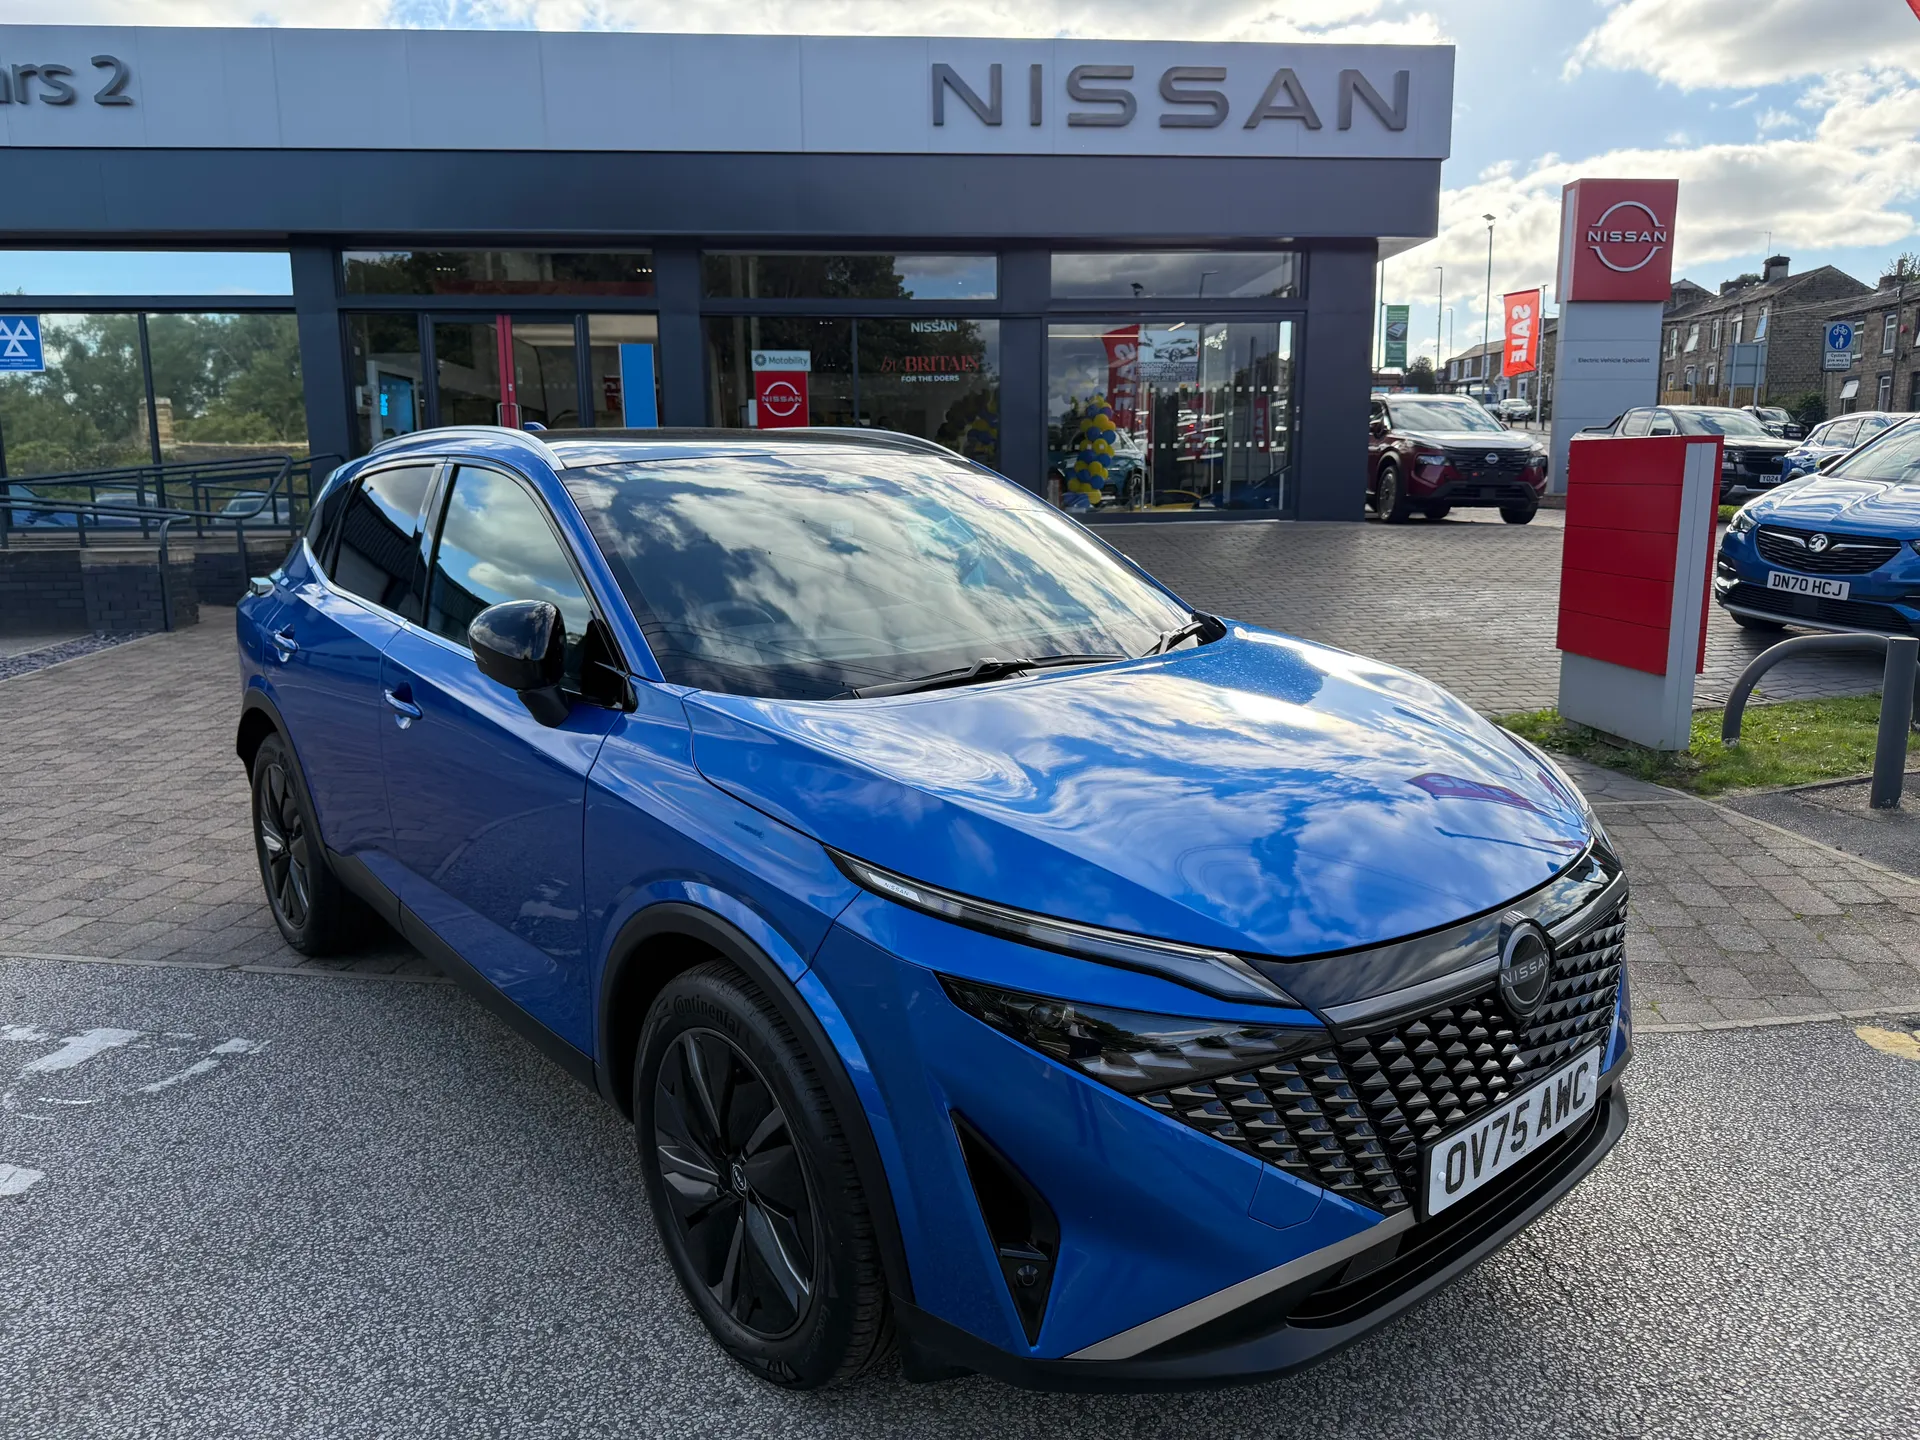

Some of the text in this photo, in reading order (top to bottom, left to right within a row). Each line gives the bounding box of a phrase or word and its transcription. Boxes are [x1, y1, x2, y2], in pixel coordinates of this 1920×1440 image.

[90, 54, 134, 107] 2
[931, 63, 1411, 131] NISSAN
[1587, 230, 1667, 243] NISSAN
[910, 321, 958, 333] NISSAN
[768, 356, 809, 367] Motobility
[904, 355, 980, 373] BRITAIN
[1622, 357, 1650, 365] Specialist
[901, 375, 917, 383] FOR
[1772, 573, 1843, 597] DN70 HCJ
[1500, 953, 1551, 985] NISSAN
[673, 994, 741, 1038] Continental
[1445, 1061, 1589, 1195] OV75 AWC
